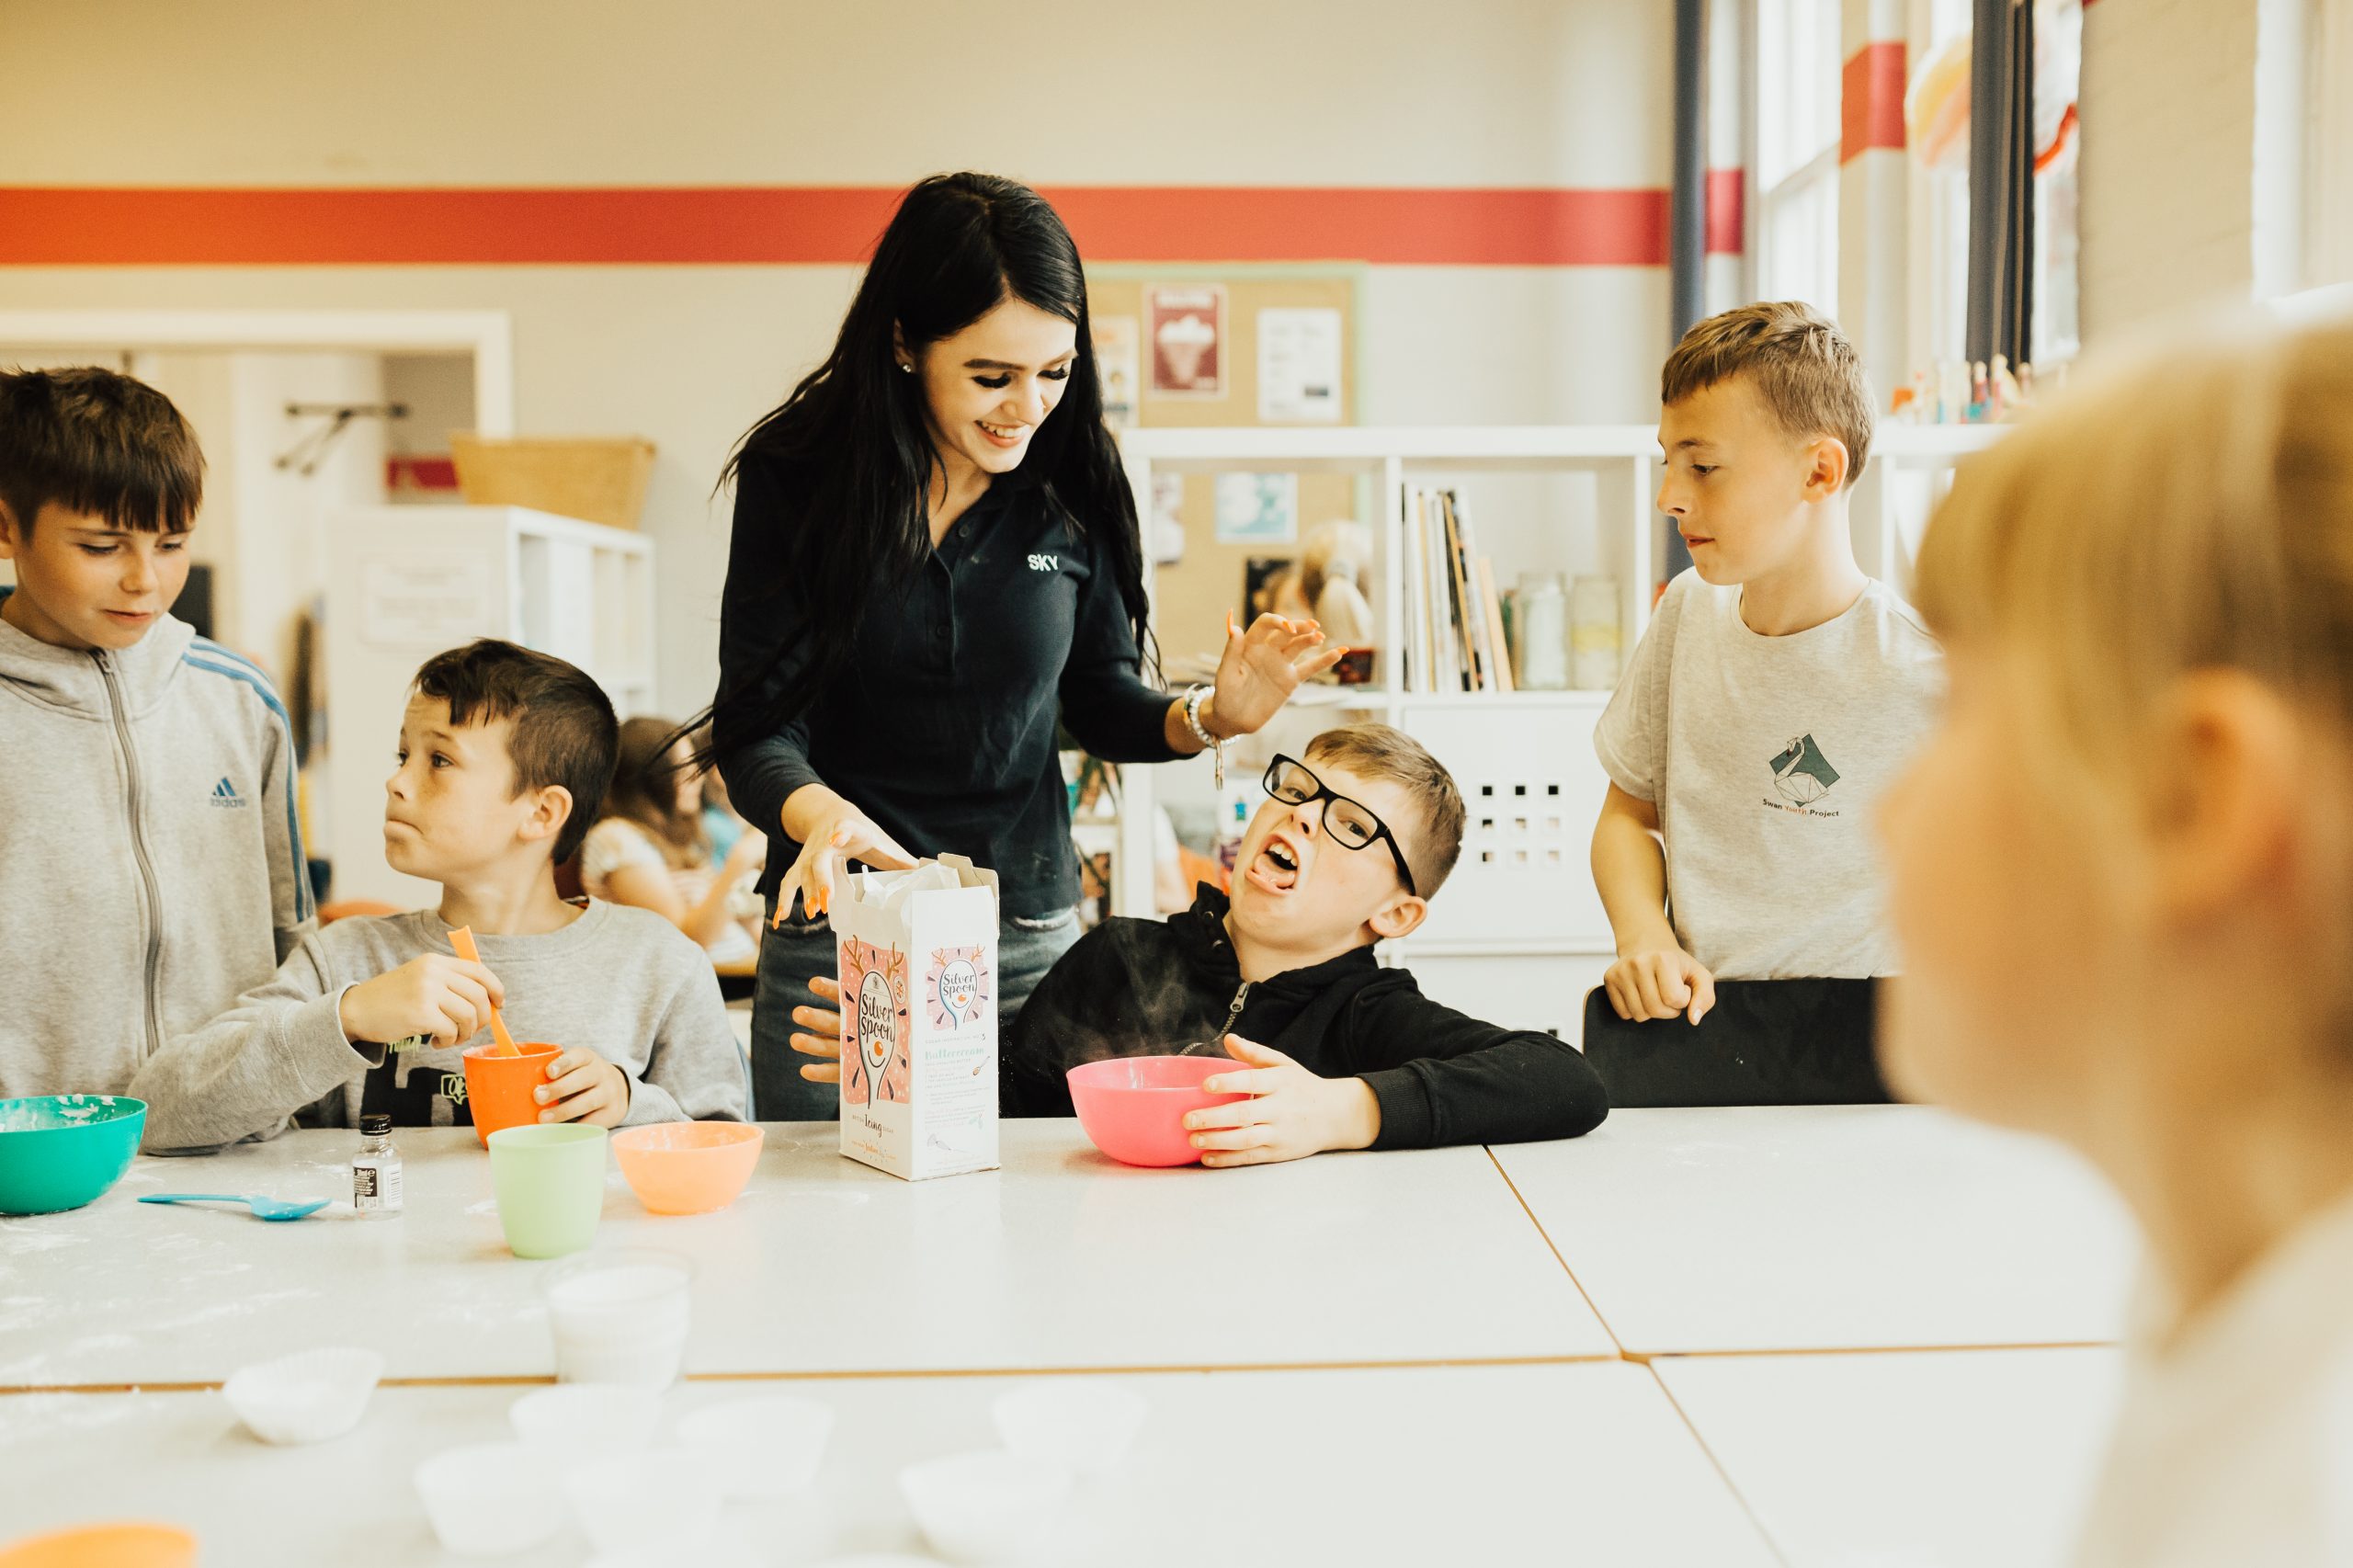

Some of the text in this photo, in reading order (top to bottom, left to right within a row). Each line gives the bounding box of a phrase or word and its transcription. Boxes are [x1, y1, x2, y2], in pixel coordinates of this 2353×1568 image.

[1028, 553, 1058, 571] SKY
[1762, 798, 1839, 818] Swan Youth Project
[943, 973, 974, 985] Silver
[861, 993, 892, 1023] Silver
[865, 1113, 882, 1139] Icing
